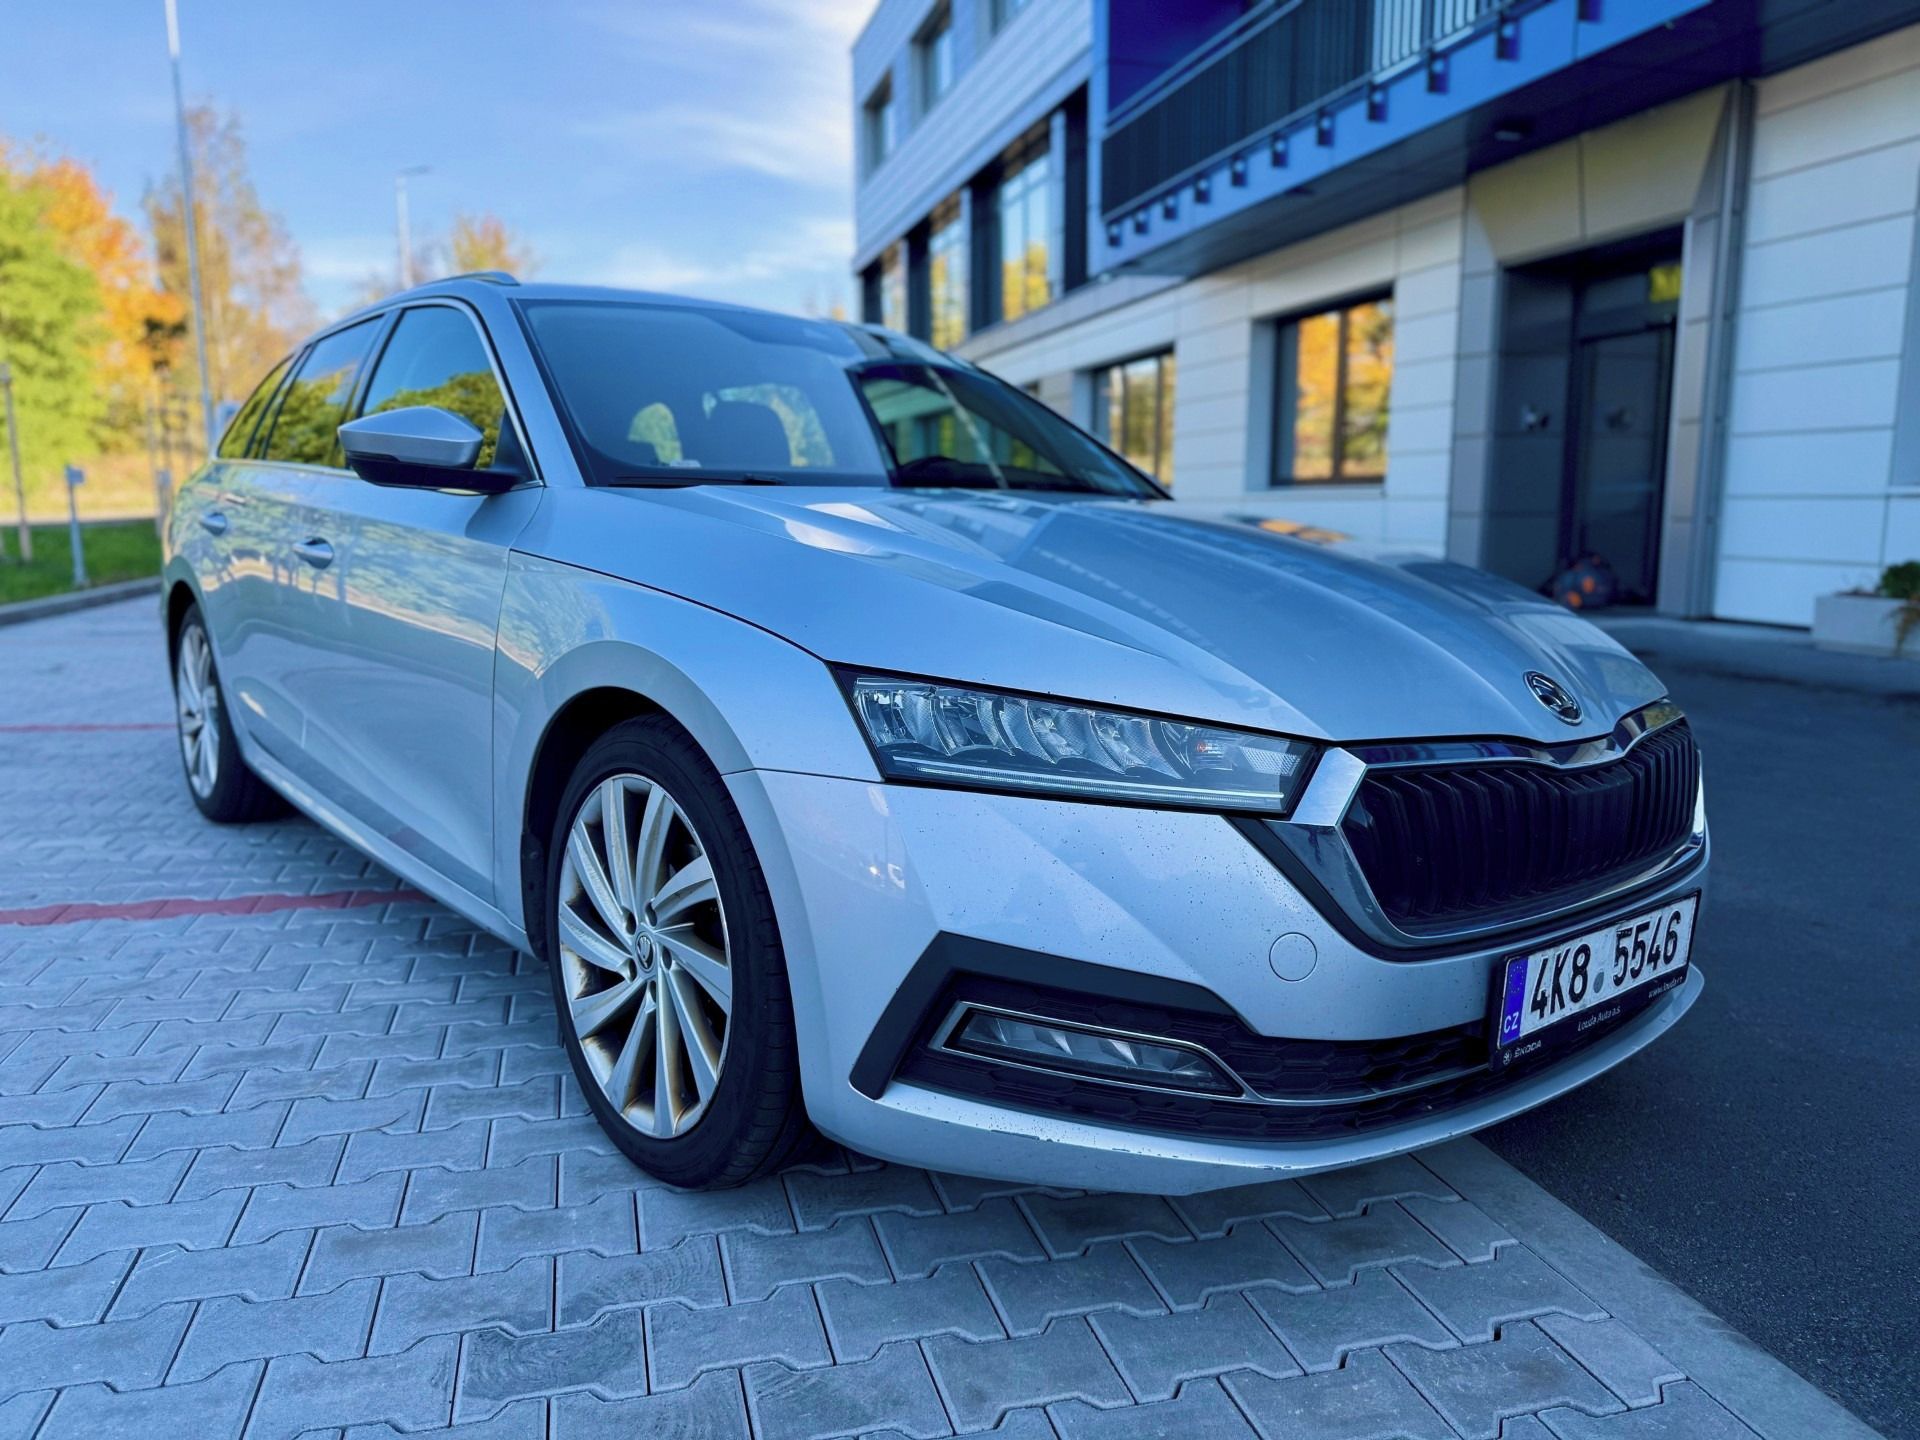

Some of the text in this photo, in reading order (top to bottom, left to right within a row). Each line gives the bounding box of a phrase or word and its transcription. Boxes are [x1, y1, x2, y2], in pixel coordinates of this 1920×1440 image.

[1530, 910, 1681, 1020] 4K8 5546
[1503, 1011, 1520, 1034] CZ
